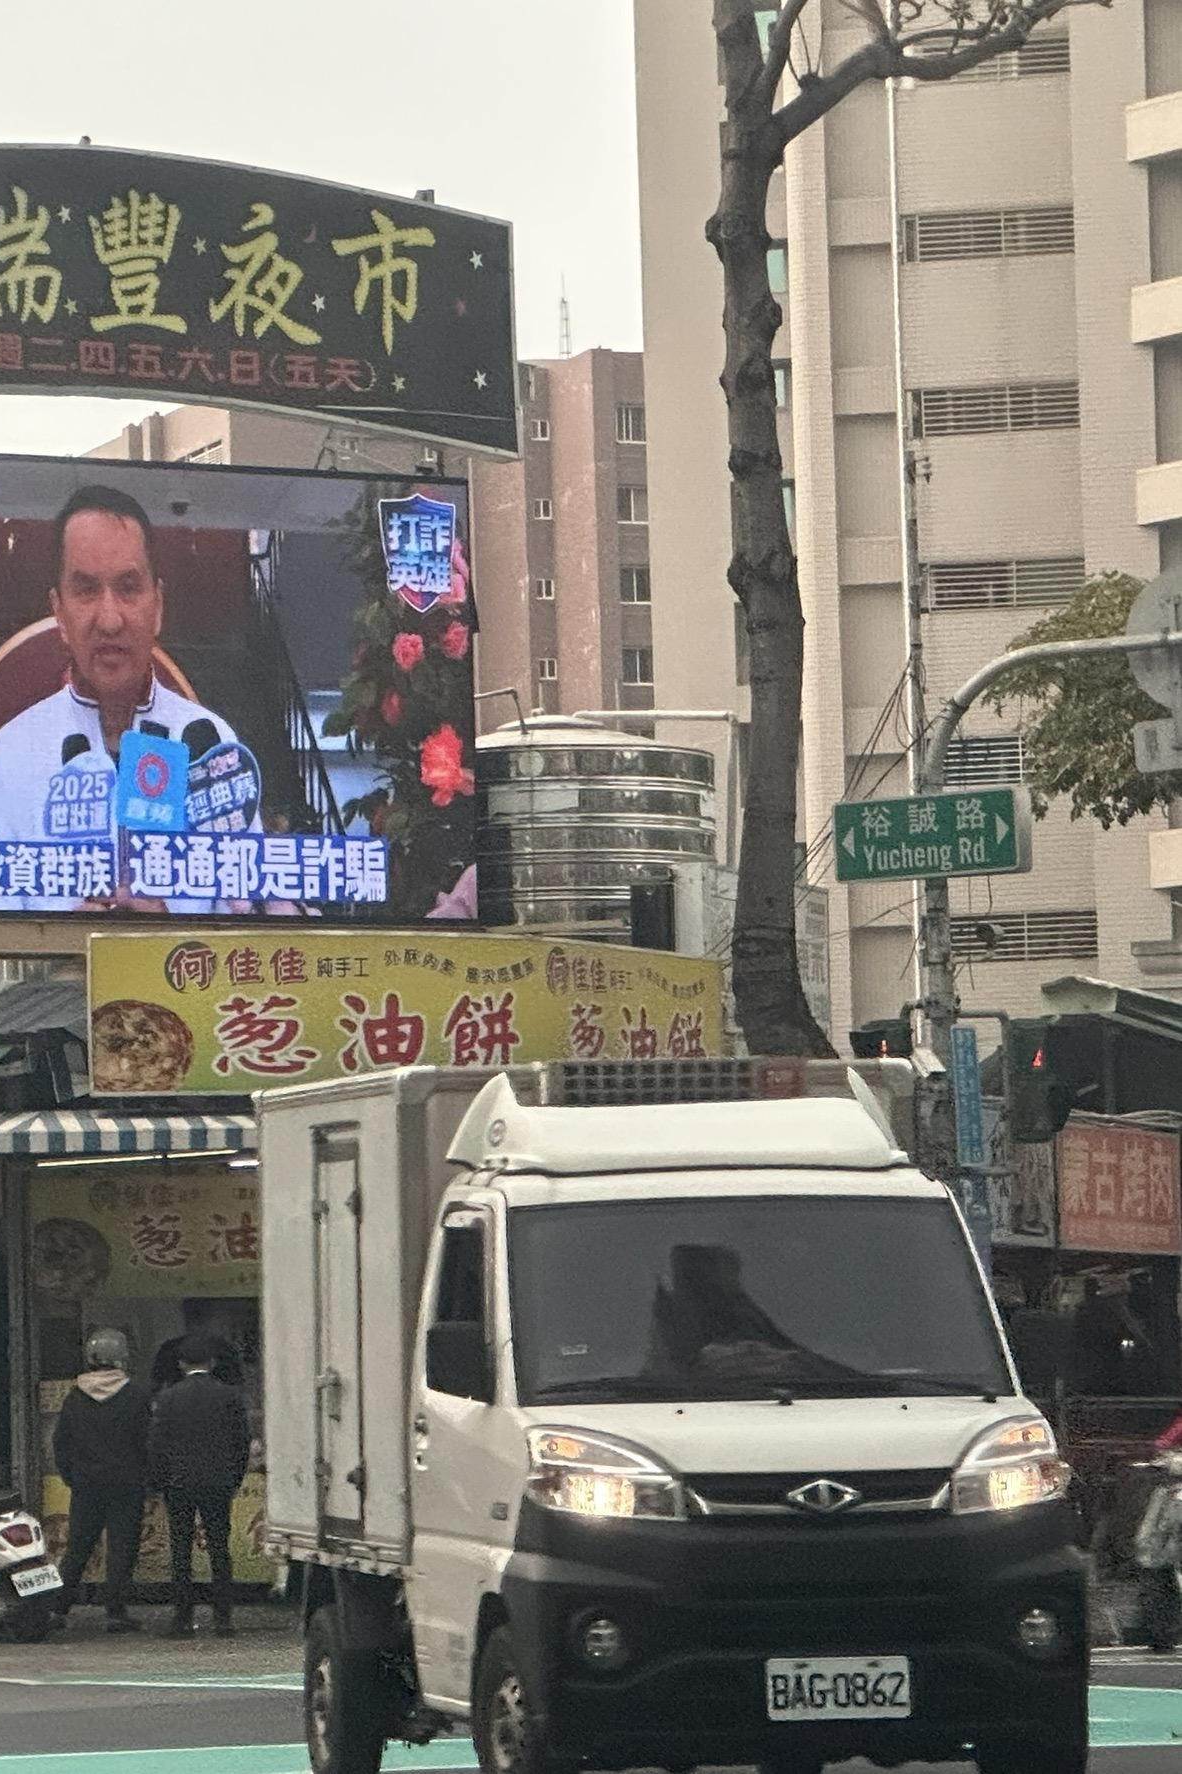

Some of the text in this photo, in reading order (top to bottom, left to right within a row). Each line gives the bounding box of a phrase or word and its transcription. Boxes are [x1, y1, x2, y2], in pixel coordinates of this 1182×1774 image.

[387, 512, 451, 553] 打詐
[49, 773, 109, 801] 2025
[861, 798, 987, 840] 裕誠路
[129, 835, 387, 903] 通通都是詐騙
[862, 841, 954, 873] Yucheng
[169, 946, 308, 991] 何佳佳
[316, 956, 370, 979] 純手工
[770, 1670, 908, 1710] BAG-0862
